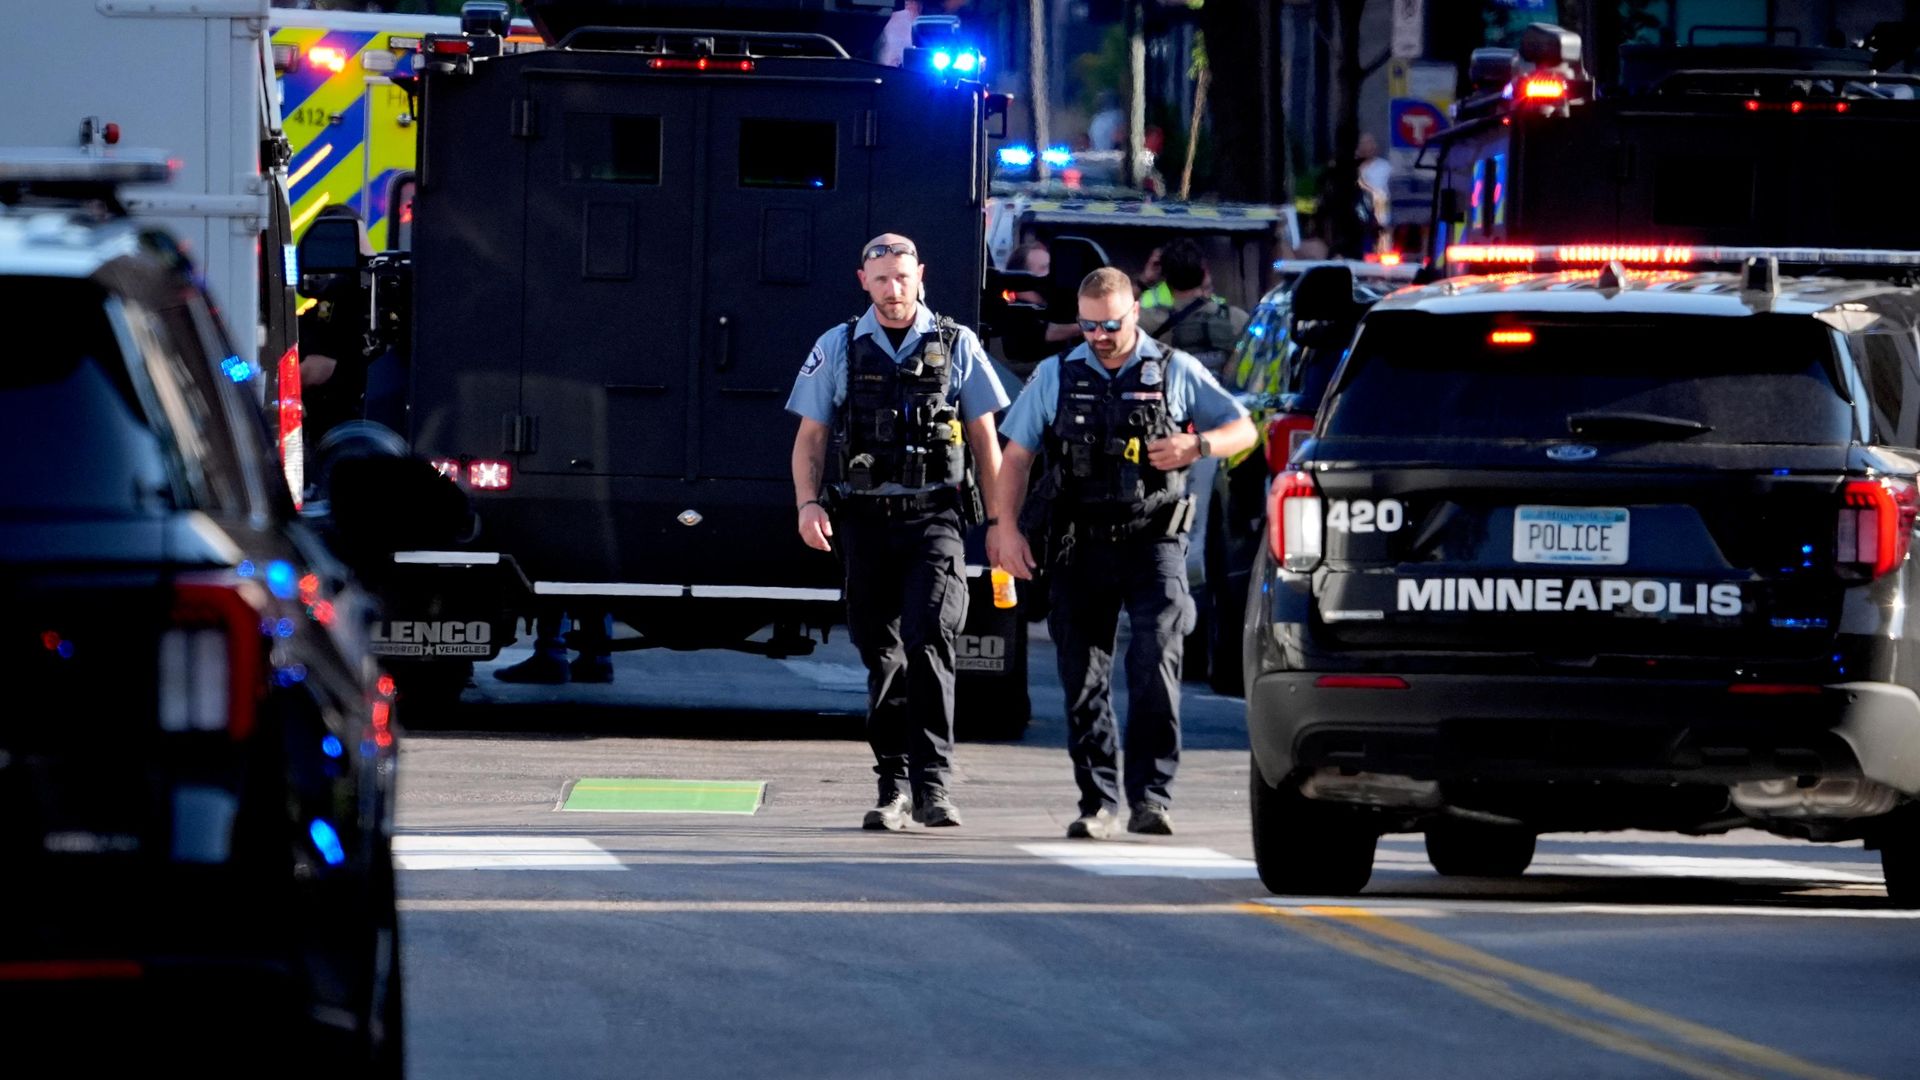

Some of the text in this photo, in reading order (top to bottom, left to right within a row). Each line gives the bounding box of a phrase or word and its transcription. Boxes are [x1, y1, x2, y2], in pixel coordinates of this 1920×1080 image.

[294, 108, 326, 127] 412
[1402, 114, 1434, 144] T
[1327, 500, 1402, 532] 420
[1528, 523, 1613, 551] POLICE
[1397, 578, 1743, 616] MINNEAPOLIS
[370, 620, 491, 643] LENCO
[439, 645, 488, 654] VEHICLES
